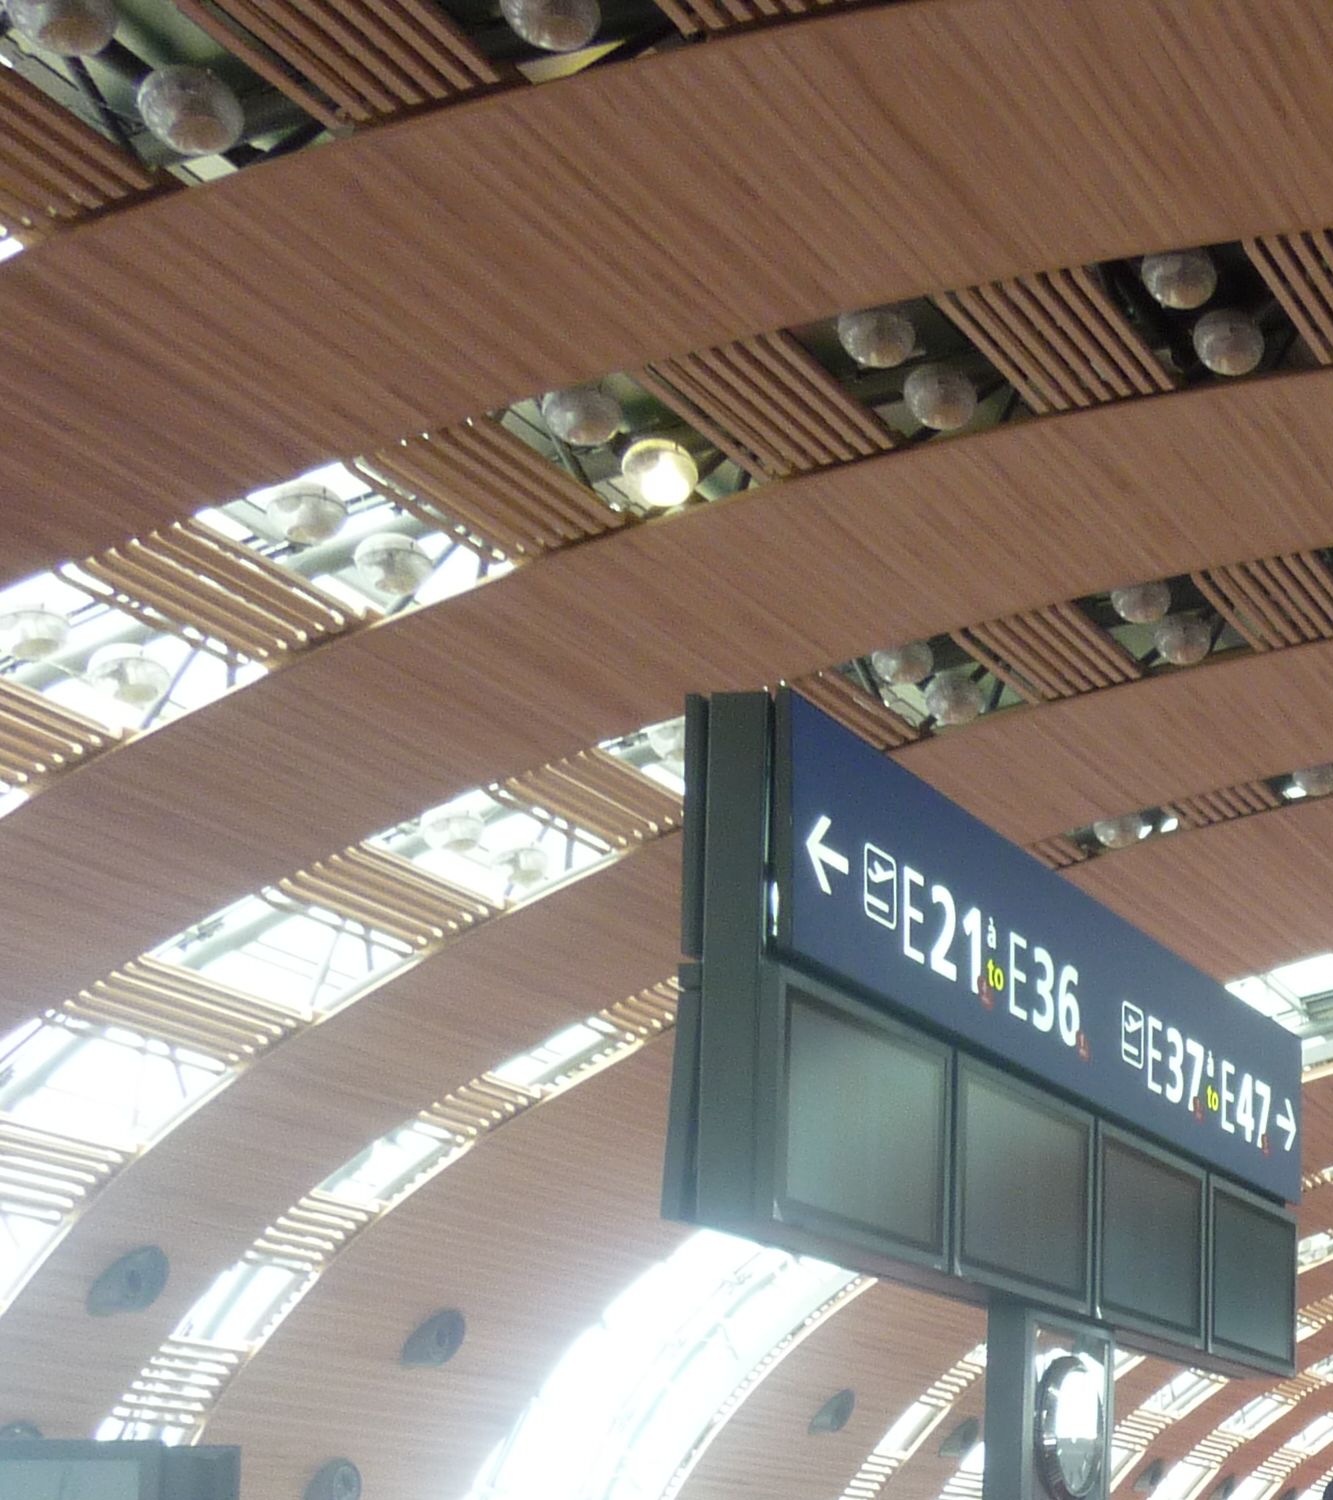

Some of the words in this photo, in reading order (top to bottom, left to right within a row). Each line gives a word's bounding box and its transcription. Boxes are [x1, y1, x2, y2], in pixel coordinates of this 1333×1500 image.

[903, 864, 982, 994] E21
[987, 916, 997, 950] à
[1009, 930, 1081, 1047] E36
[987, 959, 1005, 991] to
[1147, 1015, 1205, 1112] E37
[1221, 1059, 1271, 1149] E47
[1206, 1084, 1219, 1111] to
